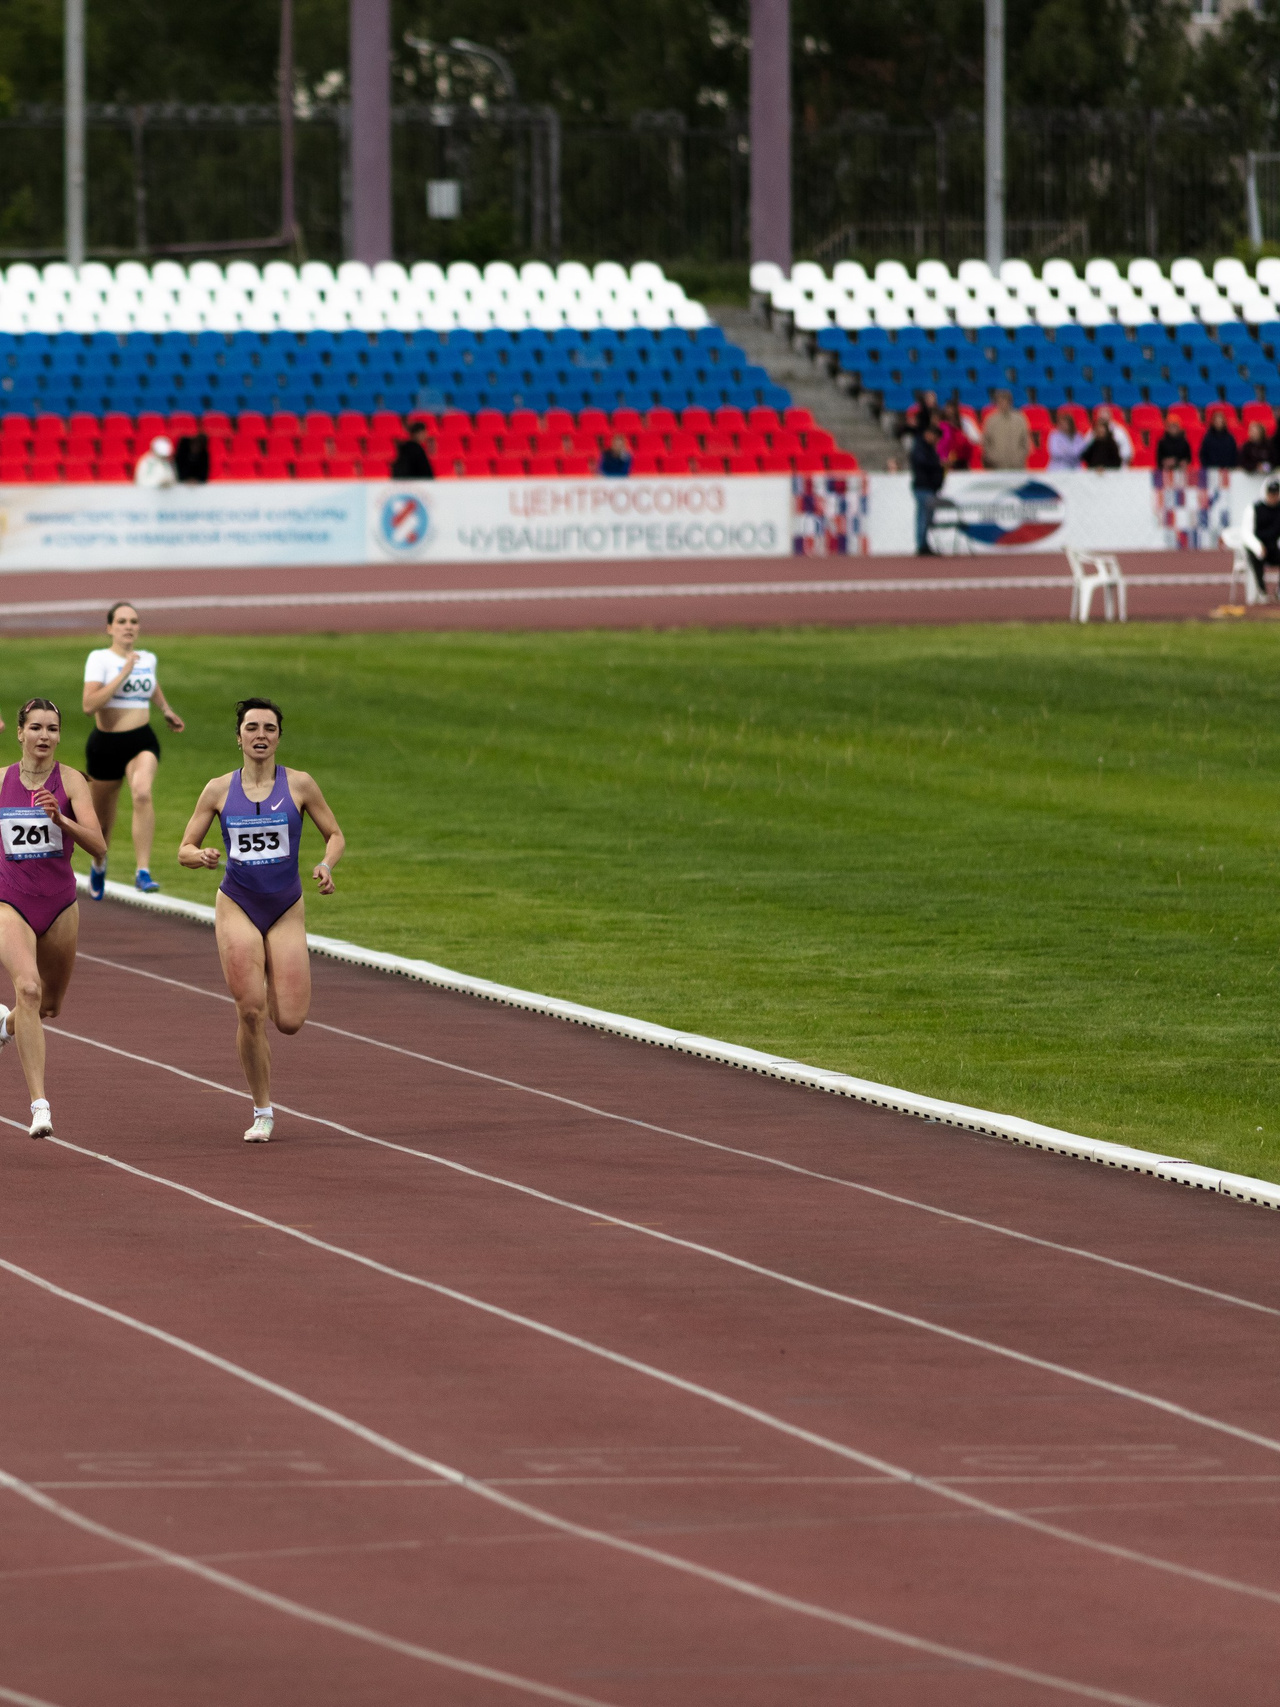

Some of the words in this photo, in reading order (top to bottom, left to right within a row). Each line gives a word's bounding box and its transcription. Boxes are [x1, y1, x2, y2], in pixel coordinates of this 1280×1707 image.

[508, 484, 726, 517] ЦЕНТРОСОЮЗ
[457, 521, 777, 554] ЧУВАШПОТРЕБСОЮЗ
[122, 678, 152, 693] 600
[11, 825, 50, 845] 261
[238, 832, 280, 853] 553
